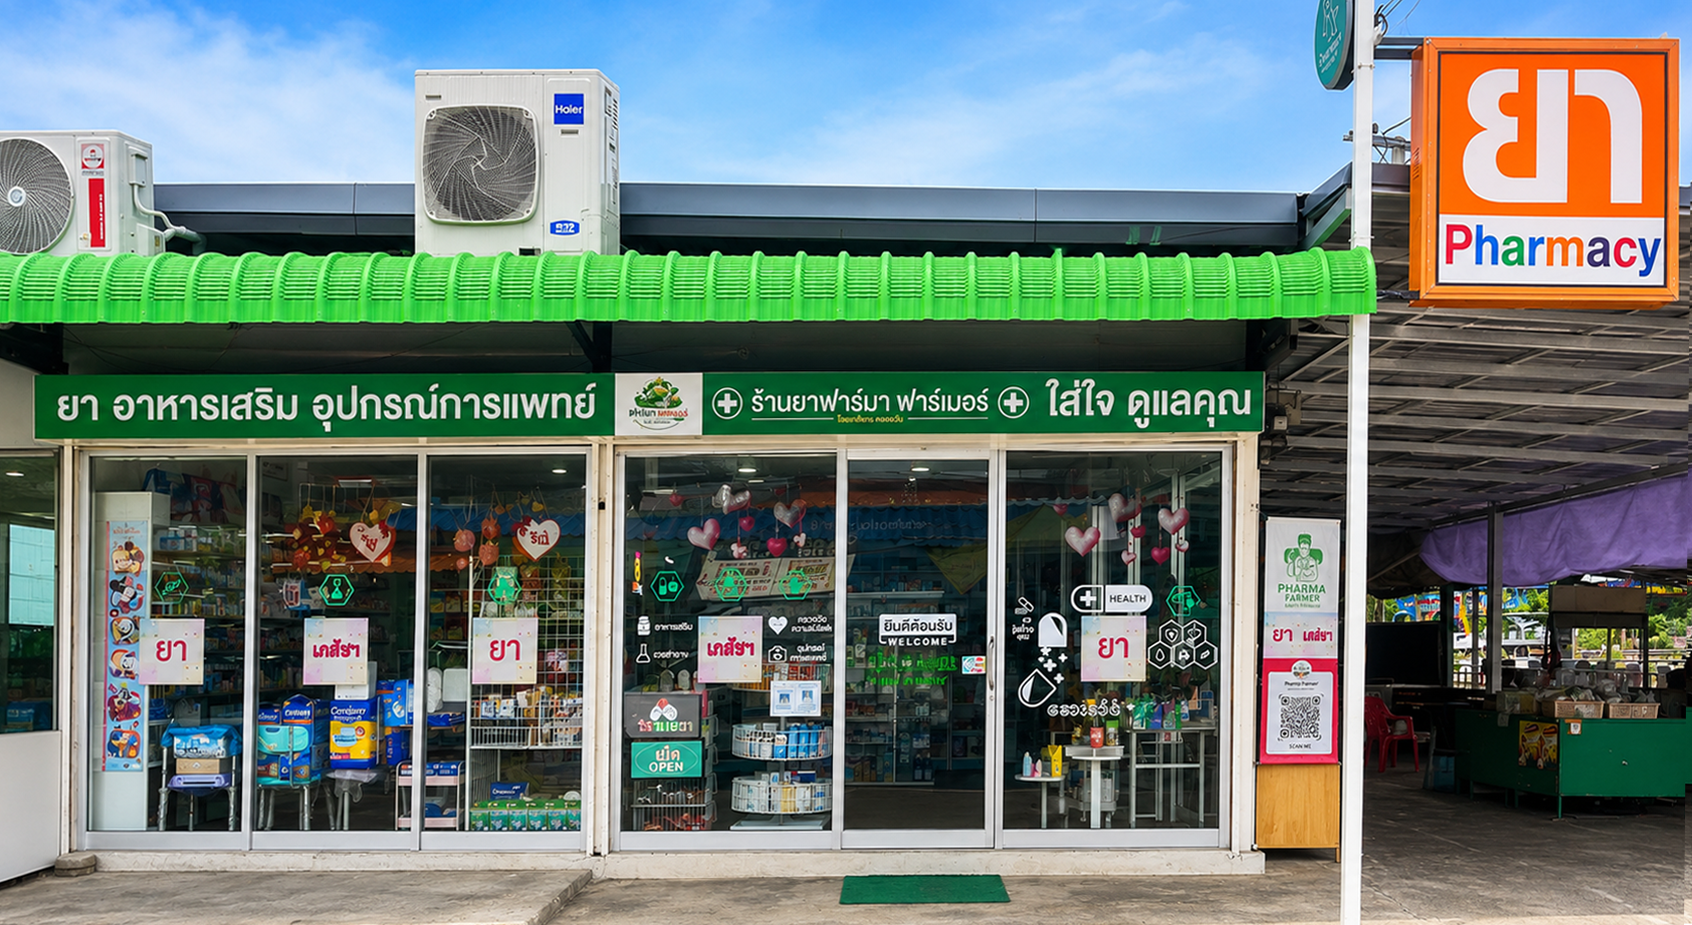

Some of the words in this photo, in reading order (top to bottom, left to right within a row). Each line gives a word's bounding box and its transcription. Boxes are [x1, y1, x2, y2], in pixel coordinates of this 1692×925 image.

[555, 104, 583, 115] Haier
[1463, 68, 1643, 204] ยา
[1445, 223, 1662, 277] Pharmacy
[57, 395, 99, 421] ยา
[113, 387, 298, 421] อาหารเสริม
[312, 382, 597, 432] อุปกรณ์การแพทย์
[751, 388, 890, 413] ร้านยาฟาร์มา
[897, 388, 989, 412] ฟาร์เมอร์
[1045, 378, 1115, 416] ใส่ใจ
[1128, 389, 1251, 428] ดูแลคุณ
[1278, 583, 1326, 594] PHARMA
[1109, 594, 1147, 603] HEALTH
[1285, 594, 1320, 602] FARMER
[884, 618, 953, 632] ยินดีต้อนรับ
[888, 637, 947, 646] WELCOME
[1272, 628, 1293, 642] ยา
[156, 639, 187, 661] ยา
[489, 639, 521, 661] ยา
[1098, 636, 1129, 659] ยา
[648, 761, 684, 773] OPEN
